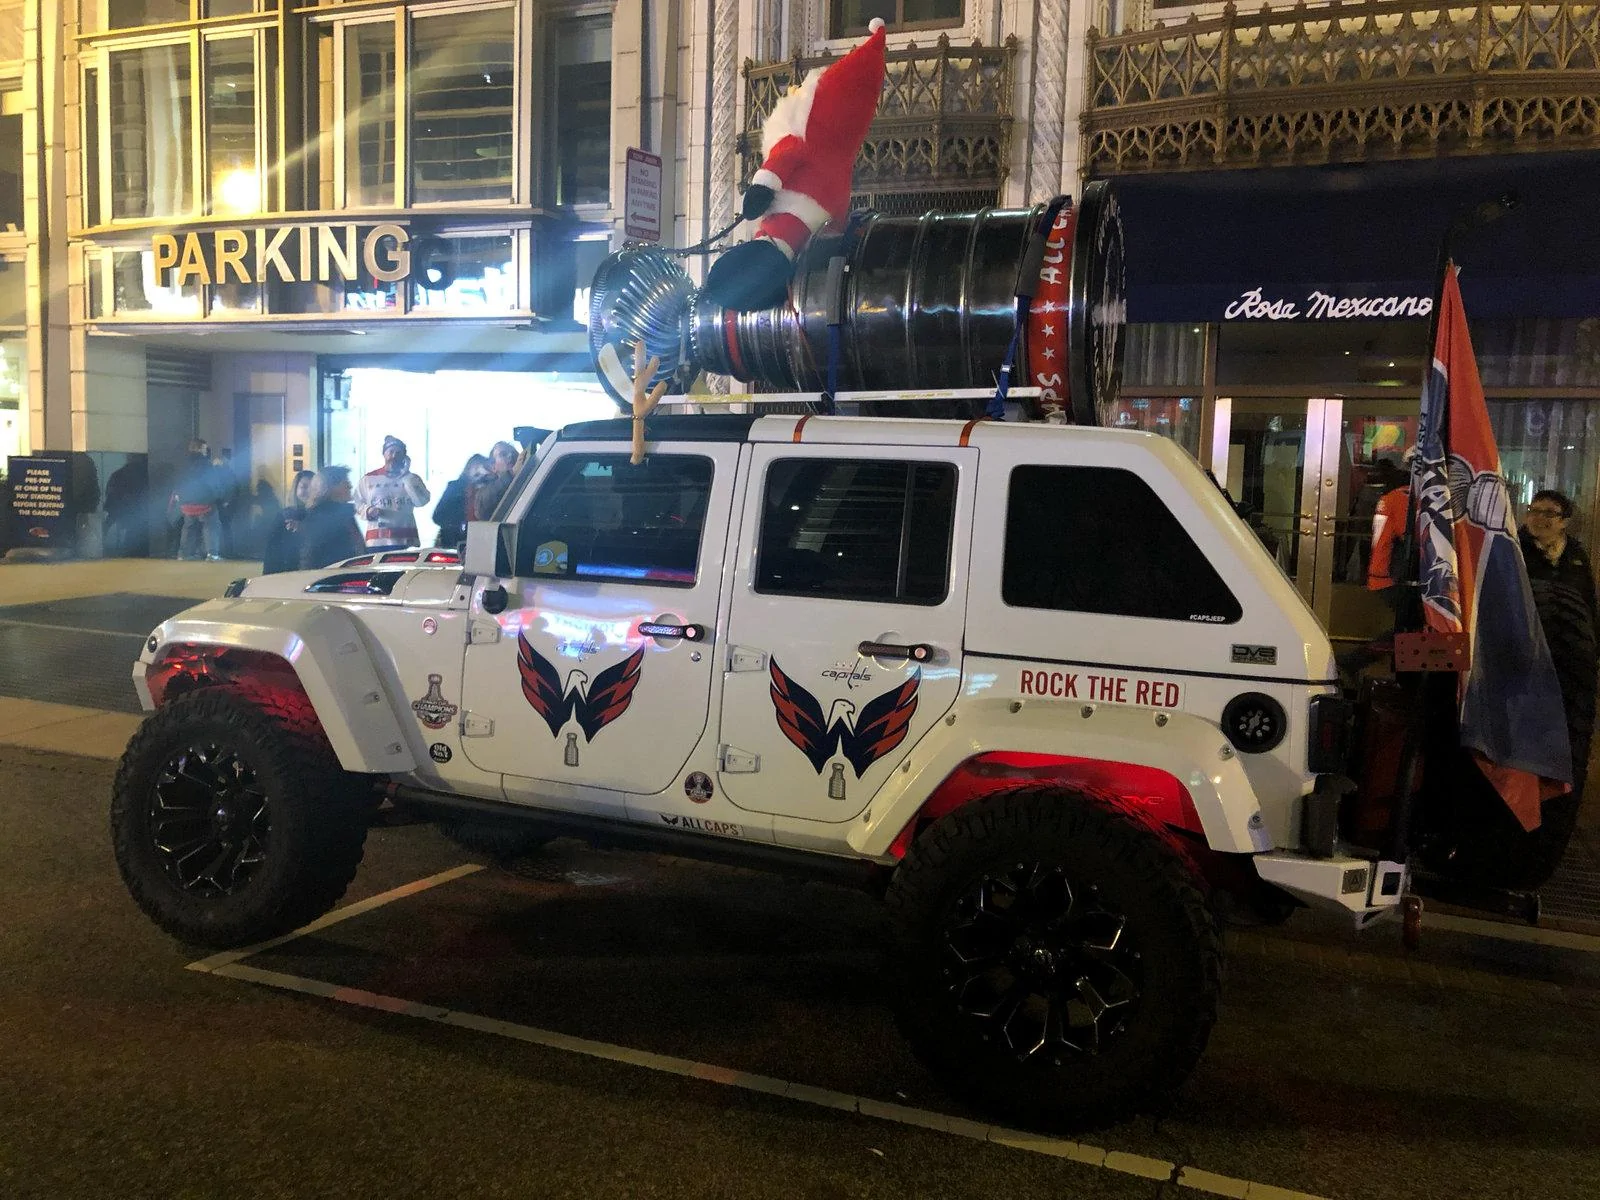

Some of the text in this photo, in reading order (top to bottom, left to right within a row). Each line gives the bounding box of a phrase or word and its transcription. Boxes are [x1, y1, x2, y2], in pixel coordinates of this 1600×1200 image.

[640, 168, 649, 177] NO
[152, 224, 411, 287] PARKING
[1040, 237, 1065, 284] ALL
[1224, 286, 1433, 320] Rosa Mexicano
[1189, 614, 1226, 622] #CAPSJEEP
[1020, 669, 1179, 708] ROCK THE RED
